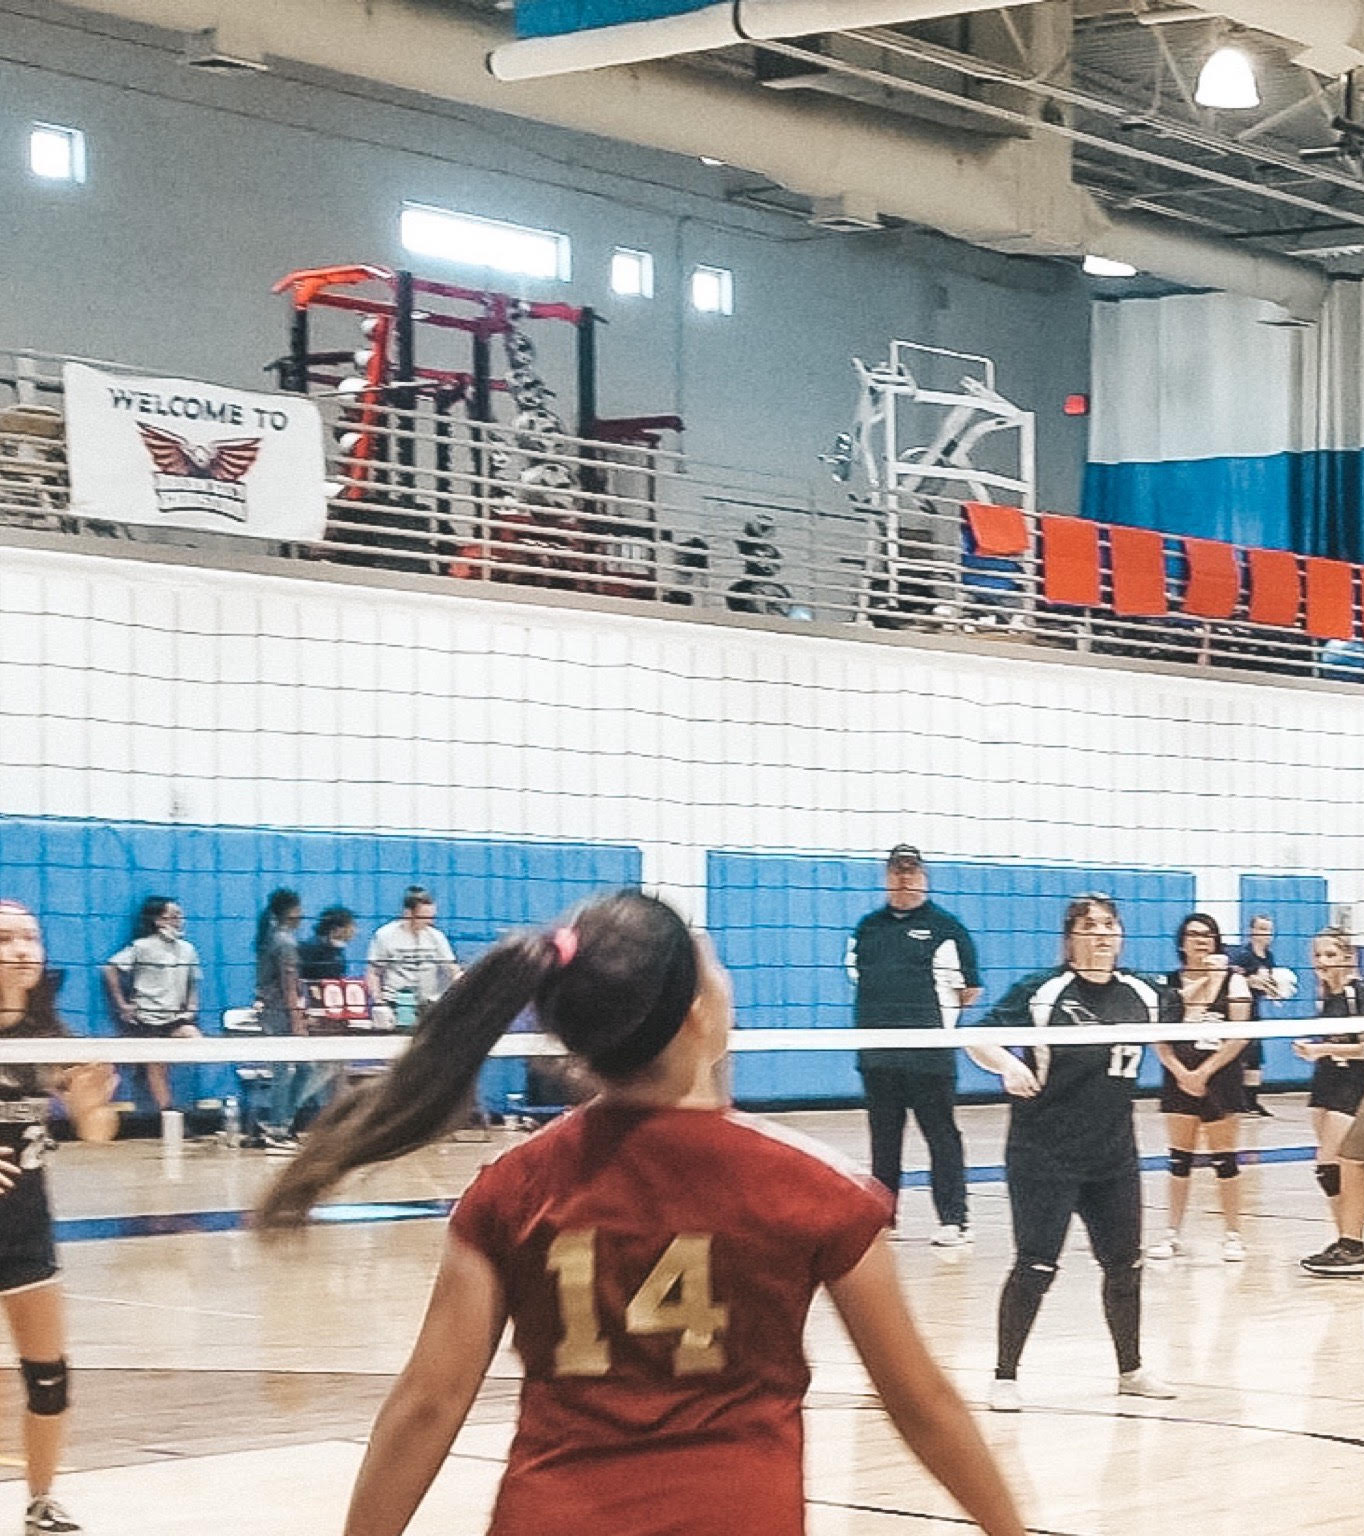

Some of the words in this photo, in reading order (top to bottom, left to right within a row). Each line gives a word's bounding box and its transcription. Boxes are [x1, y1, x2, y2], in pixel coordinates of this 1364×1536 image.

[107, 387, 244, 426] WELCOME
[252, 407, 289, 432] TO
[1107, 1044, 1144, 1079] 17
[546, 1228, 730, 1378] 14
